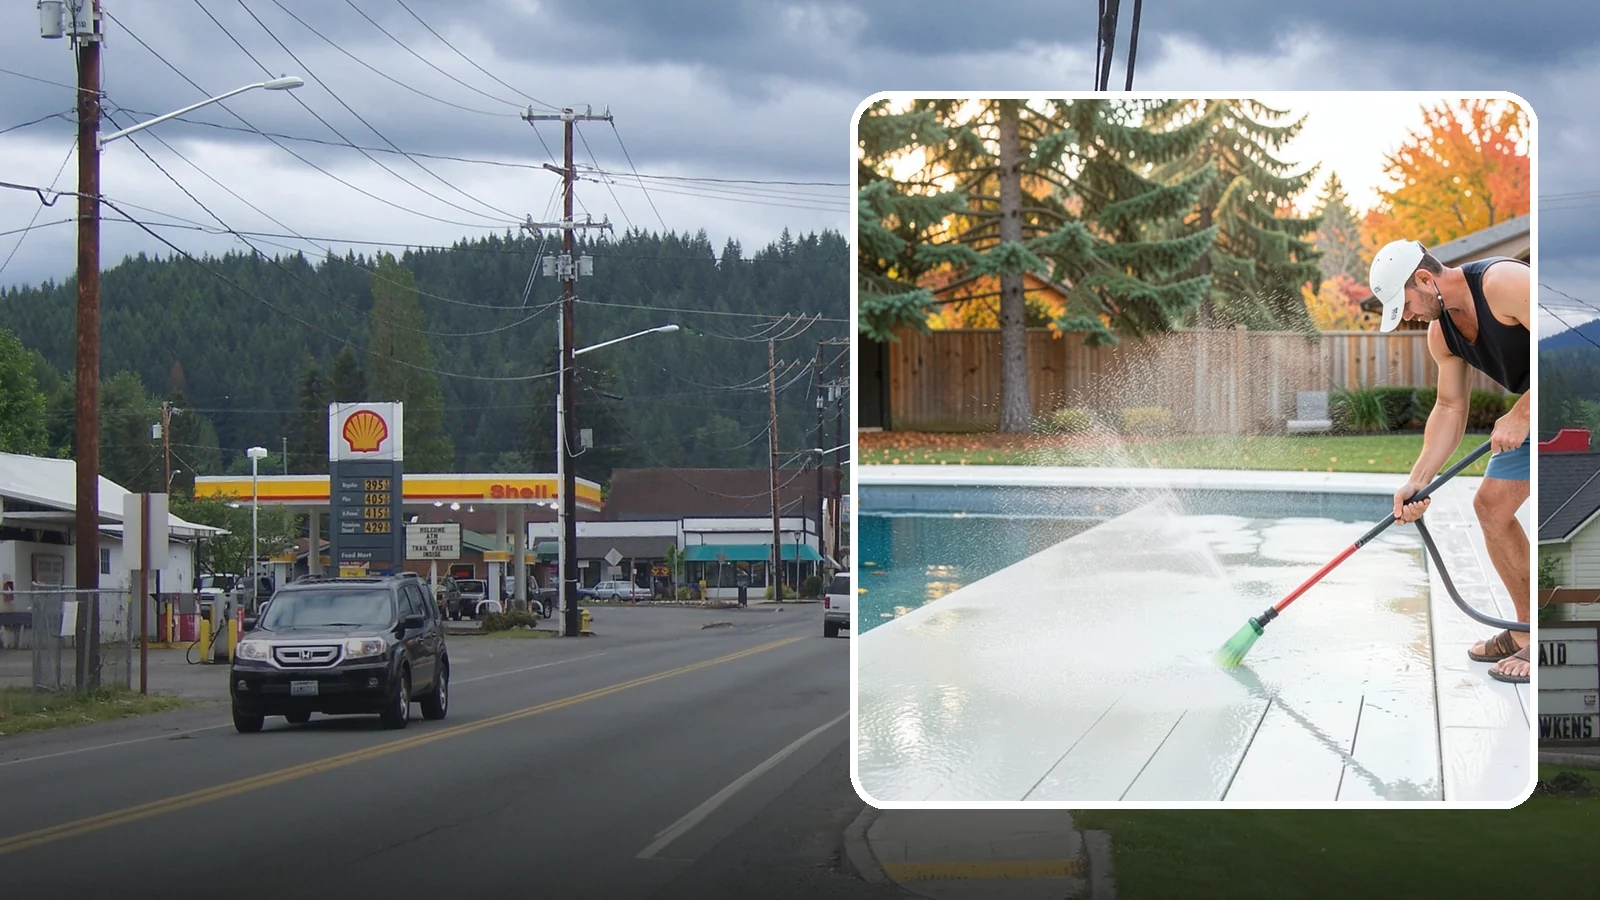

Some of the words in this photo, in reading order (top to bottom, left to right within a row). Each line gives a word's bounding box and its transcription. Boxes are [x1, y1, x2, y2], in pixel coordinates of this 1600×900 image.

[366, 480, 383, 490] 395
[490, 484, 548, 499] Shell
[366, 494, 383, 504] 405
[366, 508, 383, 518] 415
[366, 522, 383, 532] 429
[1538, 643, 1567, 666] AID
[1538, 715, 1592, 739] WKENS
